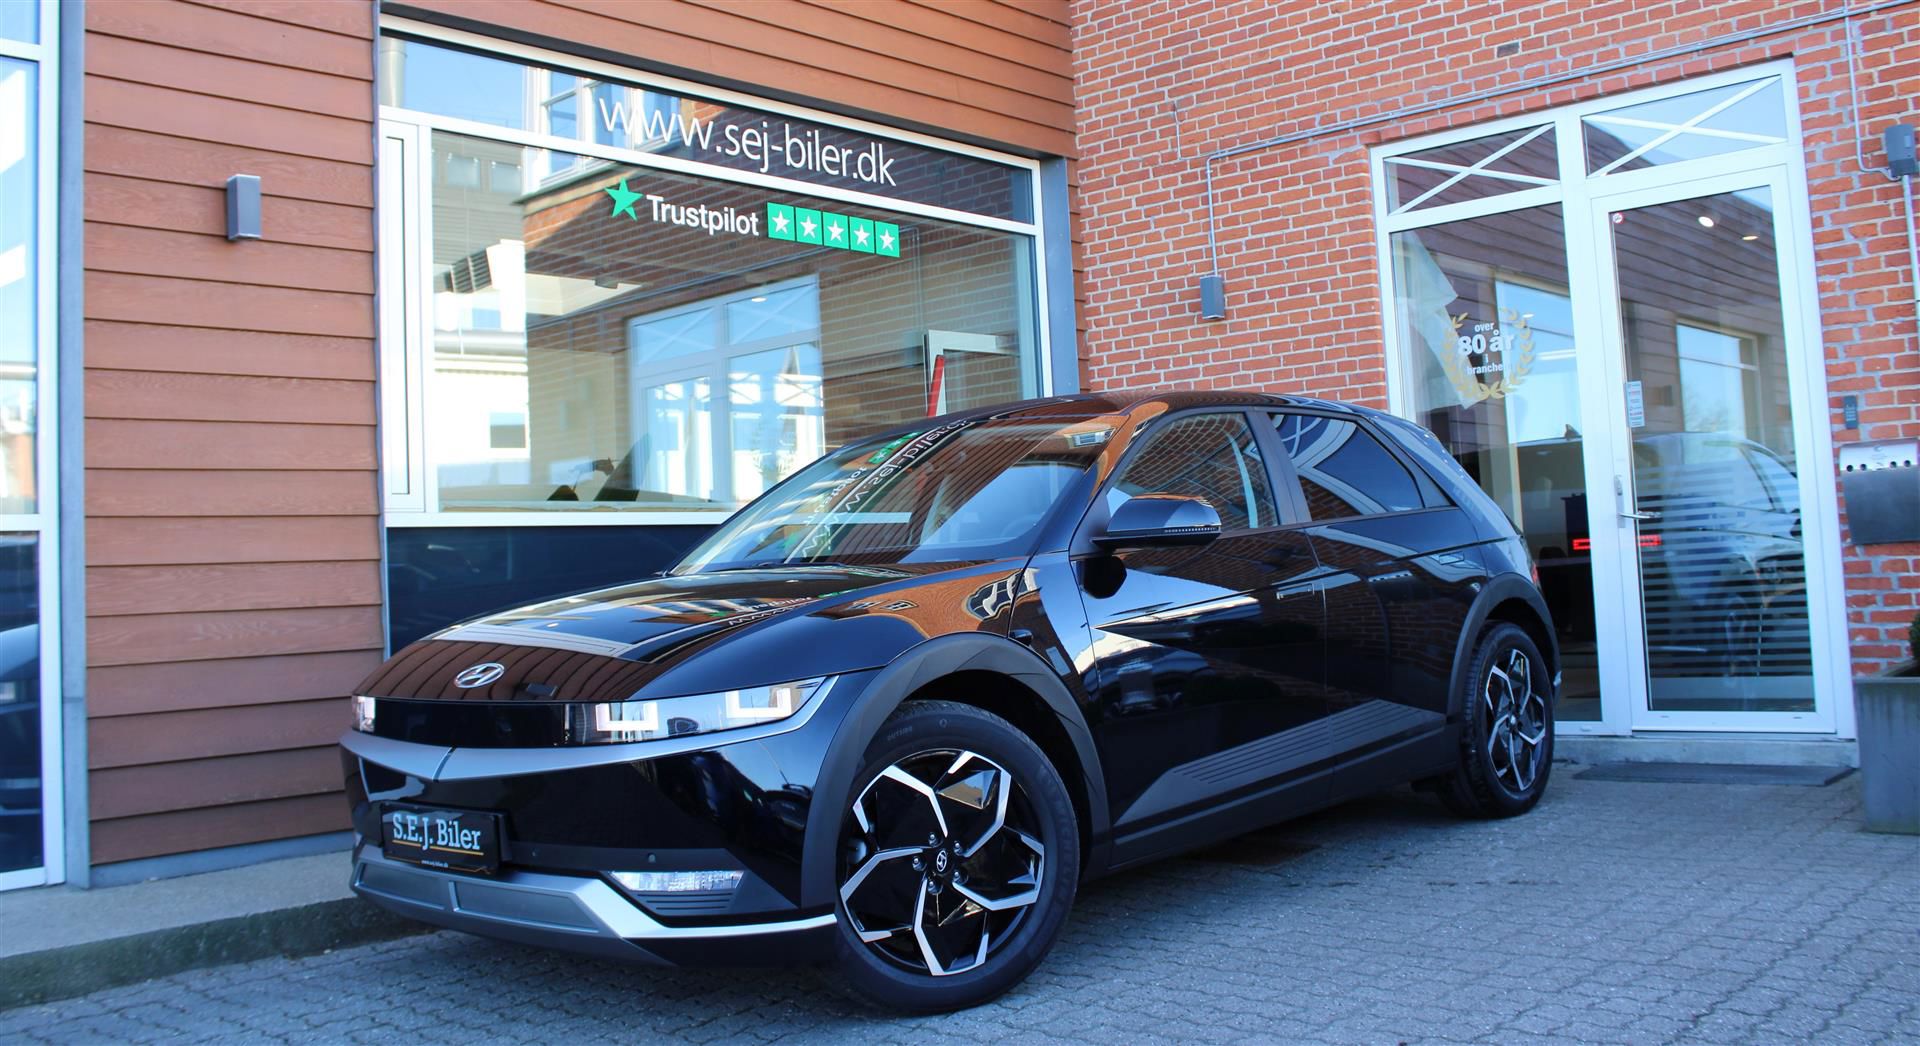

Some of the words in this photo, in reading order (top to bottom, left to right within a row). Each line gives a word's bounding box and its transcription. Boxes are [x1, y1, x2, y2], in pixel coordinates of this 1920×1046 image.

[599, 98, 897, 187] www.sej-biler.dk
[646, 194, 759, 236] Trustpilot
[1457, 334, 1487, 355] 80
[1489, 329, 1514, 352] år
[1474, 322, 1495, 332] over
[392, 813, 433, 850] S.E.J.
[436, 818, 481, 850] Biler
